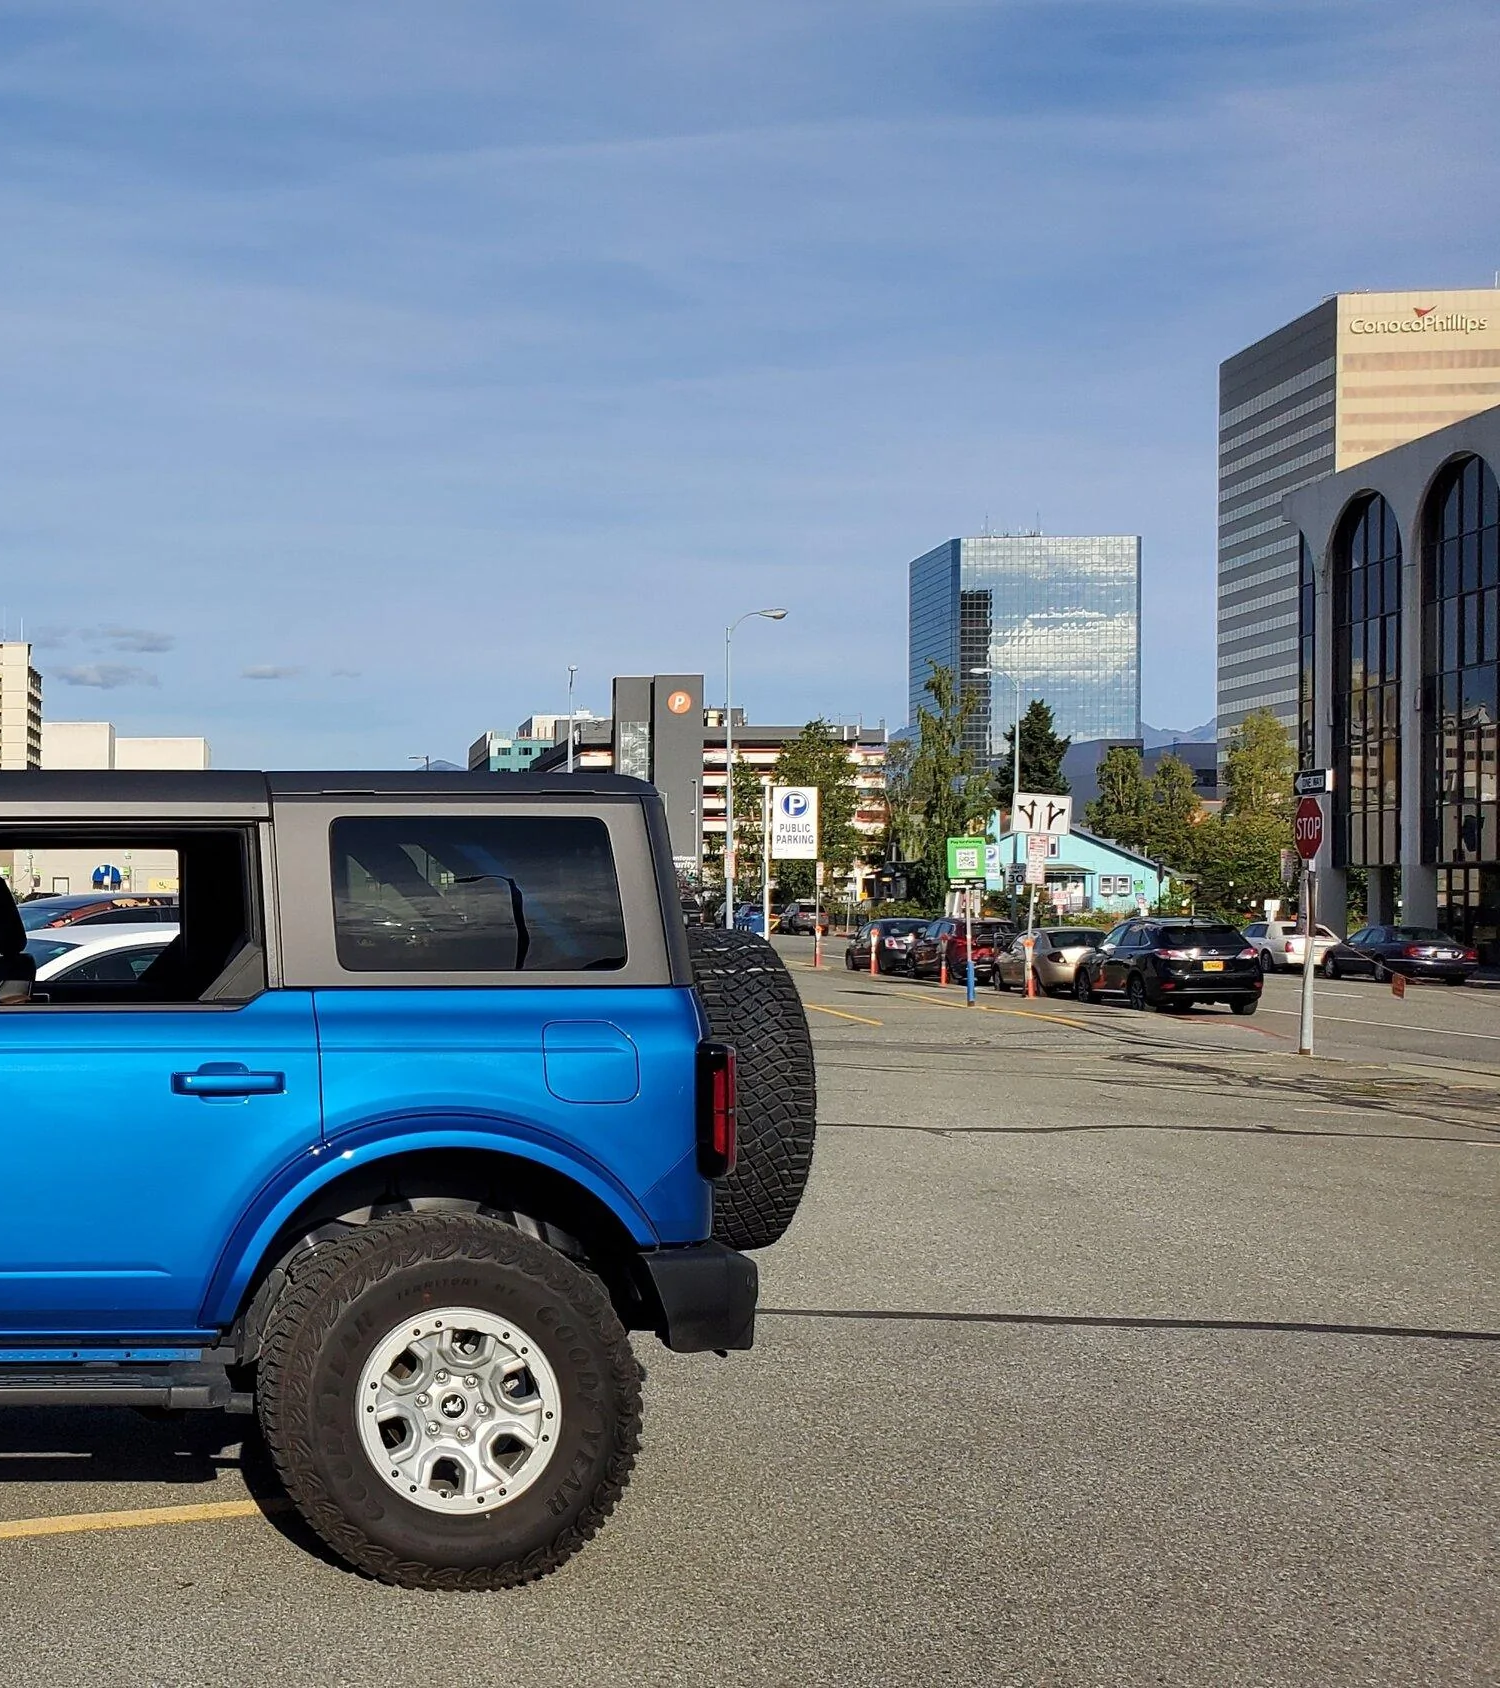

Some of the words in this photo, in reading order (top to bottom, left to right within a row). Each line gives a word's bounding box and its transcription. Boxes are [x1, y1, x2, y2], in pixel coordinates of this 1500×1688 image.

[1350, 313, 1489, 335] ConocoPhillips
[779, 823, 811, 833] PUBLIC
[1296, 816, 1321, 840] STOP
[776, 835, 814, 844] PARKING
[1007, 874, 1024, 883] 30
[535, 1305, 605, 1518] GOODYEAR
